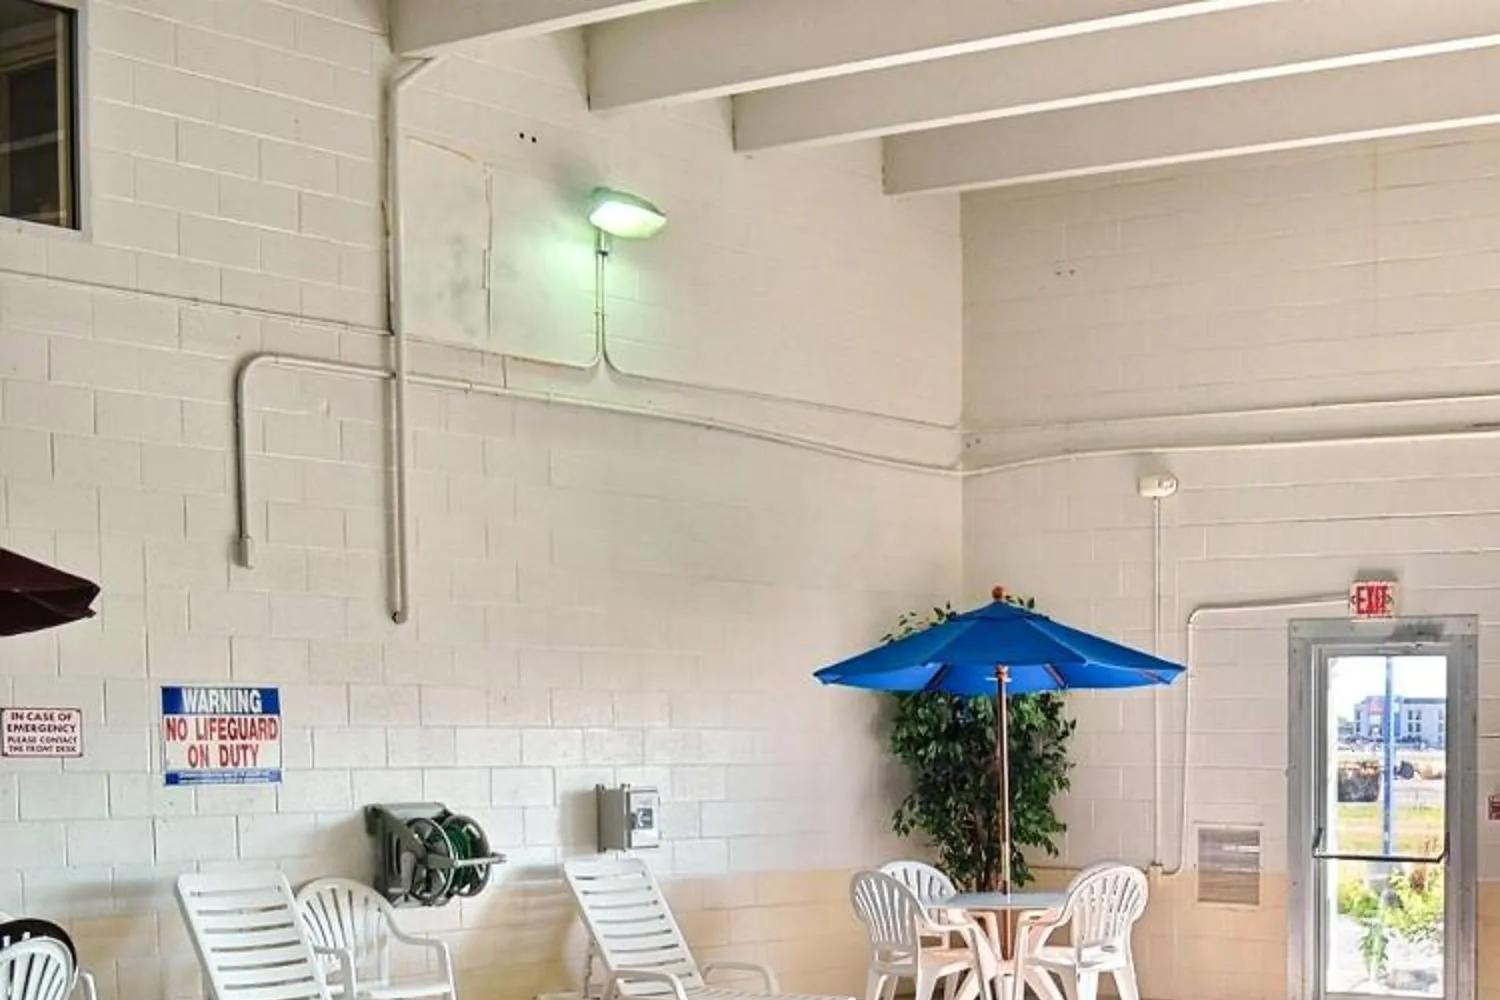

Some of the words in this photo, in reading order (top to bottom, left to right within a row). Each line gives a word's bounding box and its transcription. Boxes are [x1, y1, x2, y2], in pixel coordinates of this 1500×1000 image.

[1356, 585, 1389, 614] EXIT
[181, 687, 262, 713] WARNING
[7, 723, 76, 733] EMERGENCY
[11, 711, 24, 721] IN
[26, 711, 54, 721] CASE
[57, 712, 72, 721] OF
[166, 717, 188, 741] NO
[195, 717, 278, 741] LIFEGUARD
[187, 743, 209, 768] ON
[219, 743, 259, 767] DUTY
